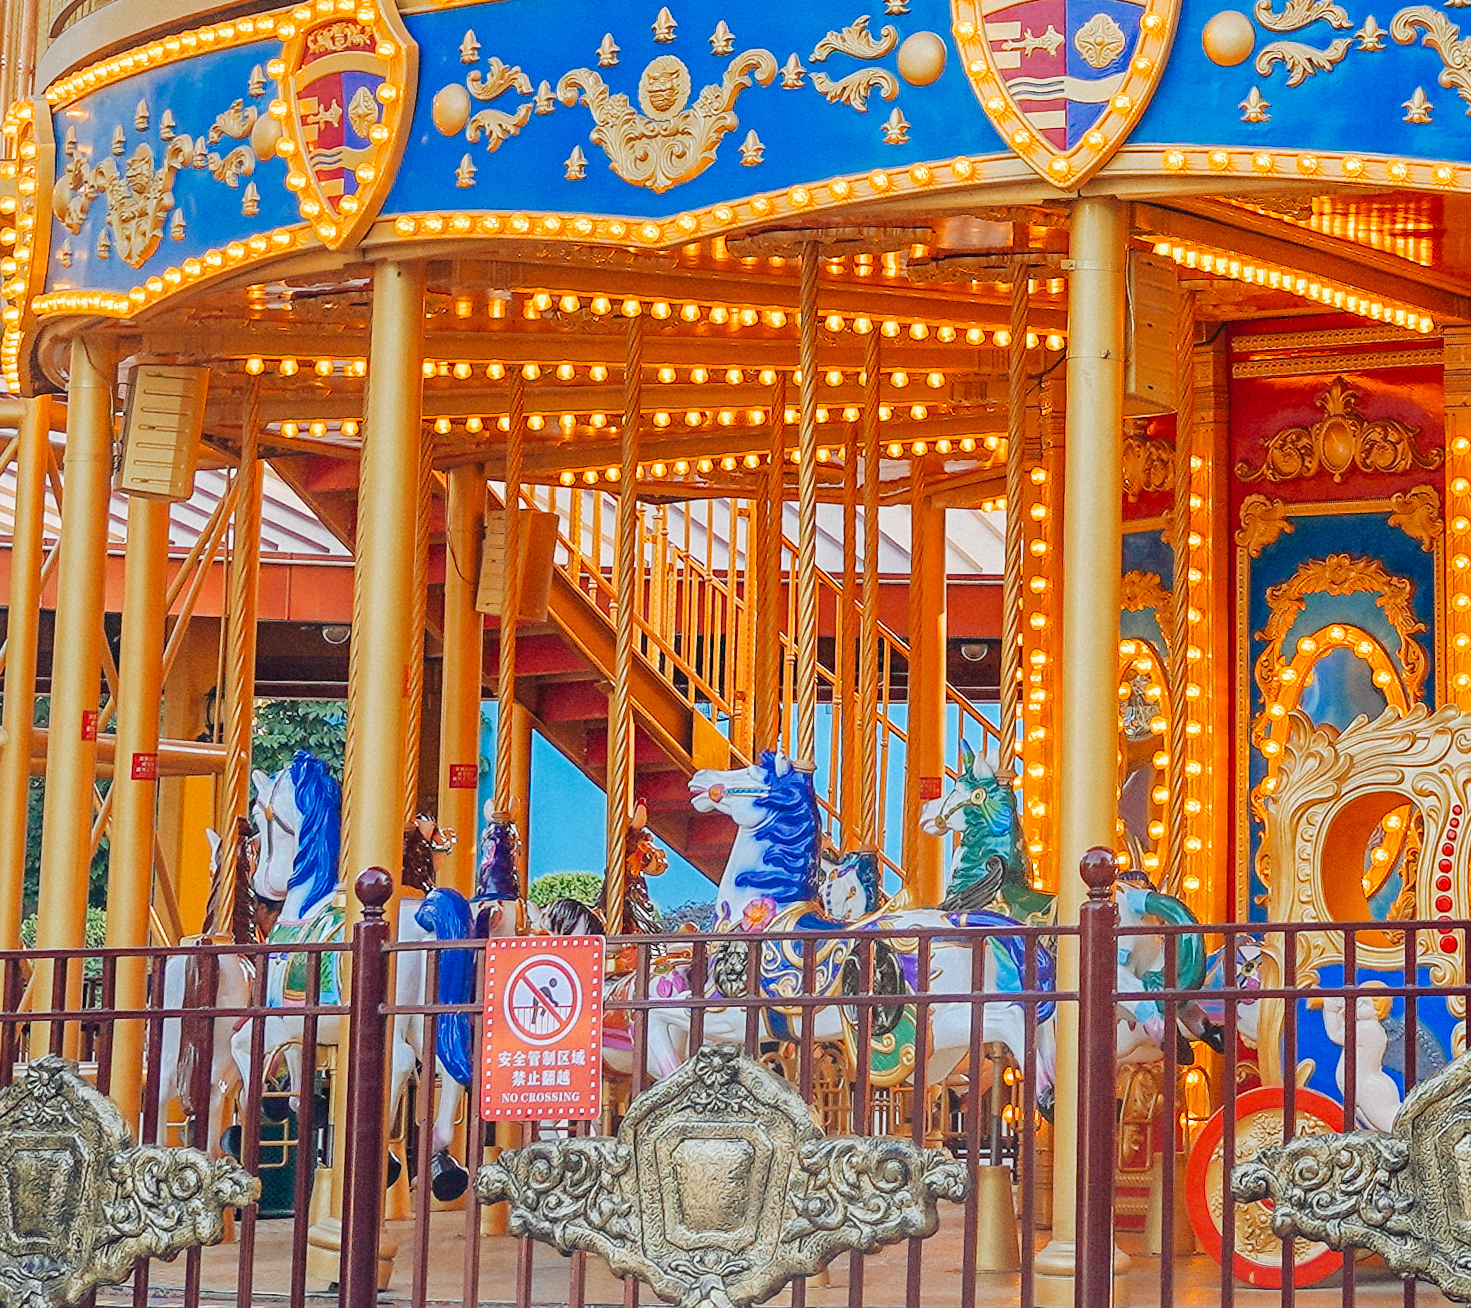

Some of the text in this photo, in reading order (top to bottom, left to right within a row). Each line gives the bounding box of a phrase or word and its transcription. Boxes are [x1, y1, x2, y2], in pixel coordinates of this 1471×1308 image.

[497, 1049, 586, 1067] 安全管制区域
[512, 1069, 571, 1087] 禁止翻越
[502, 1091, 581, 1103] NO CROSSING
